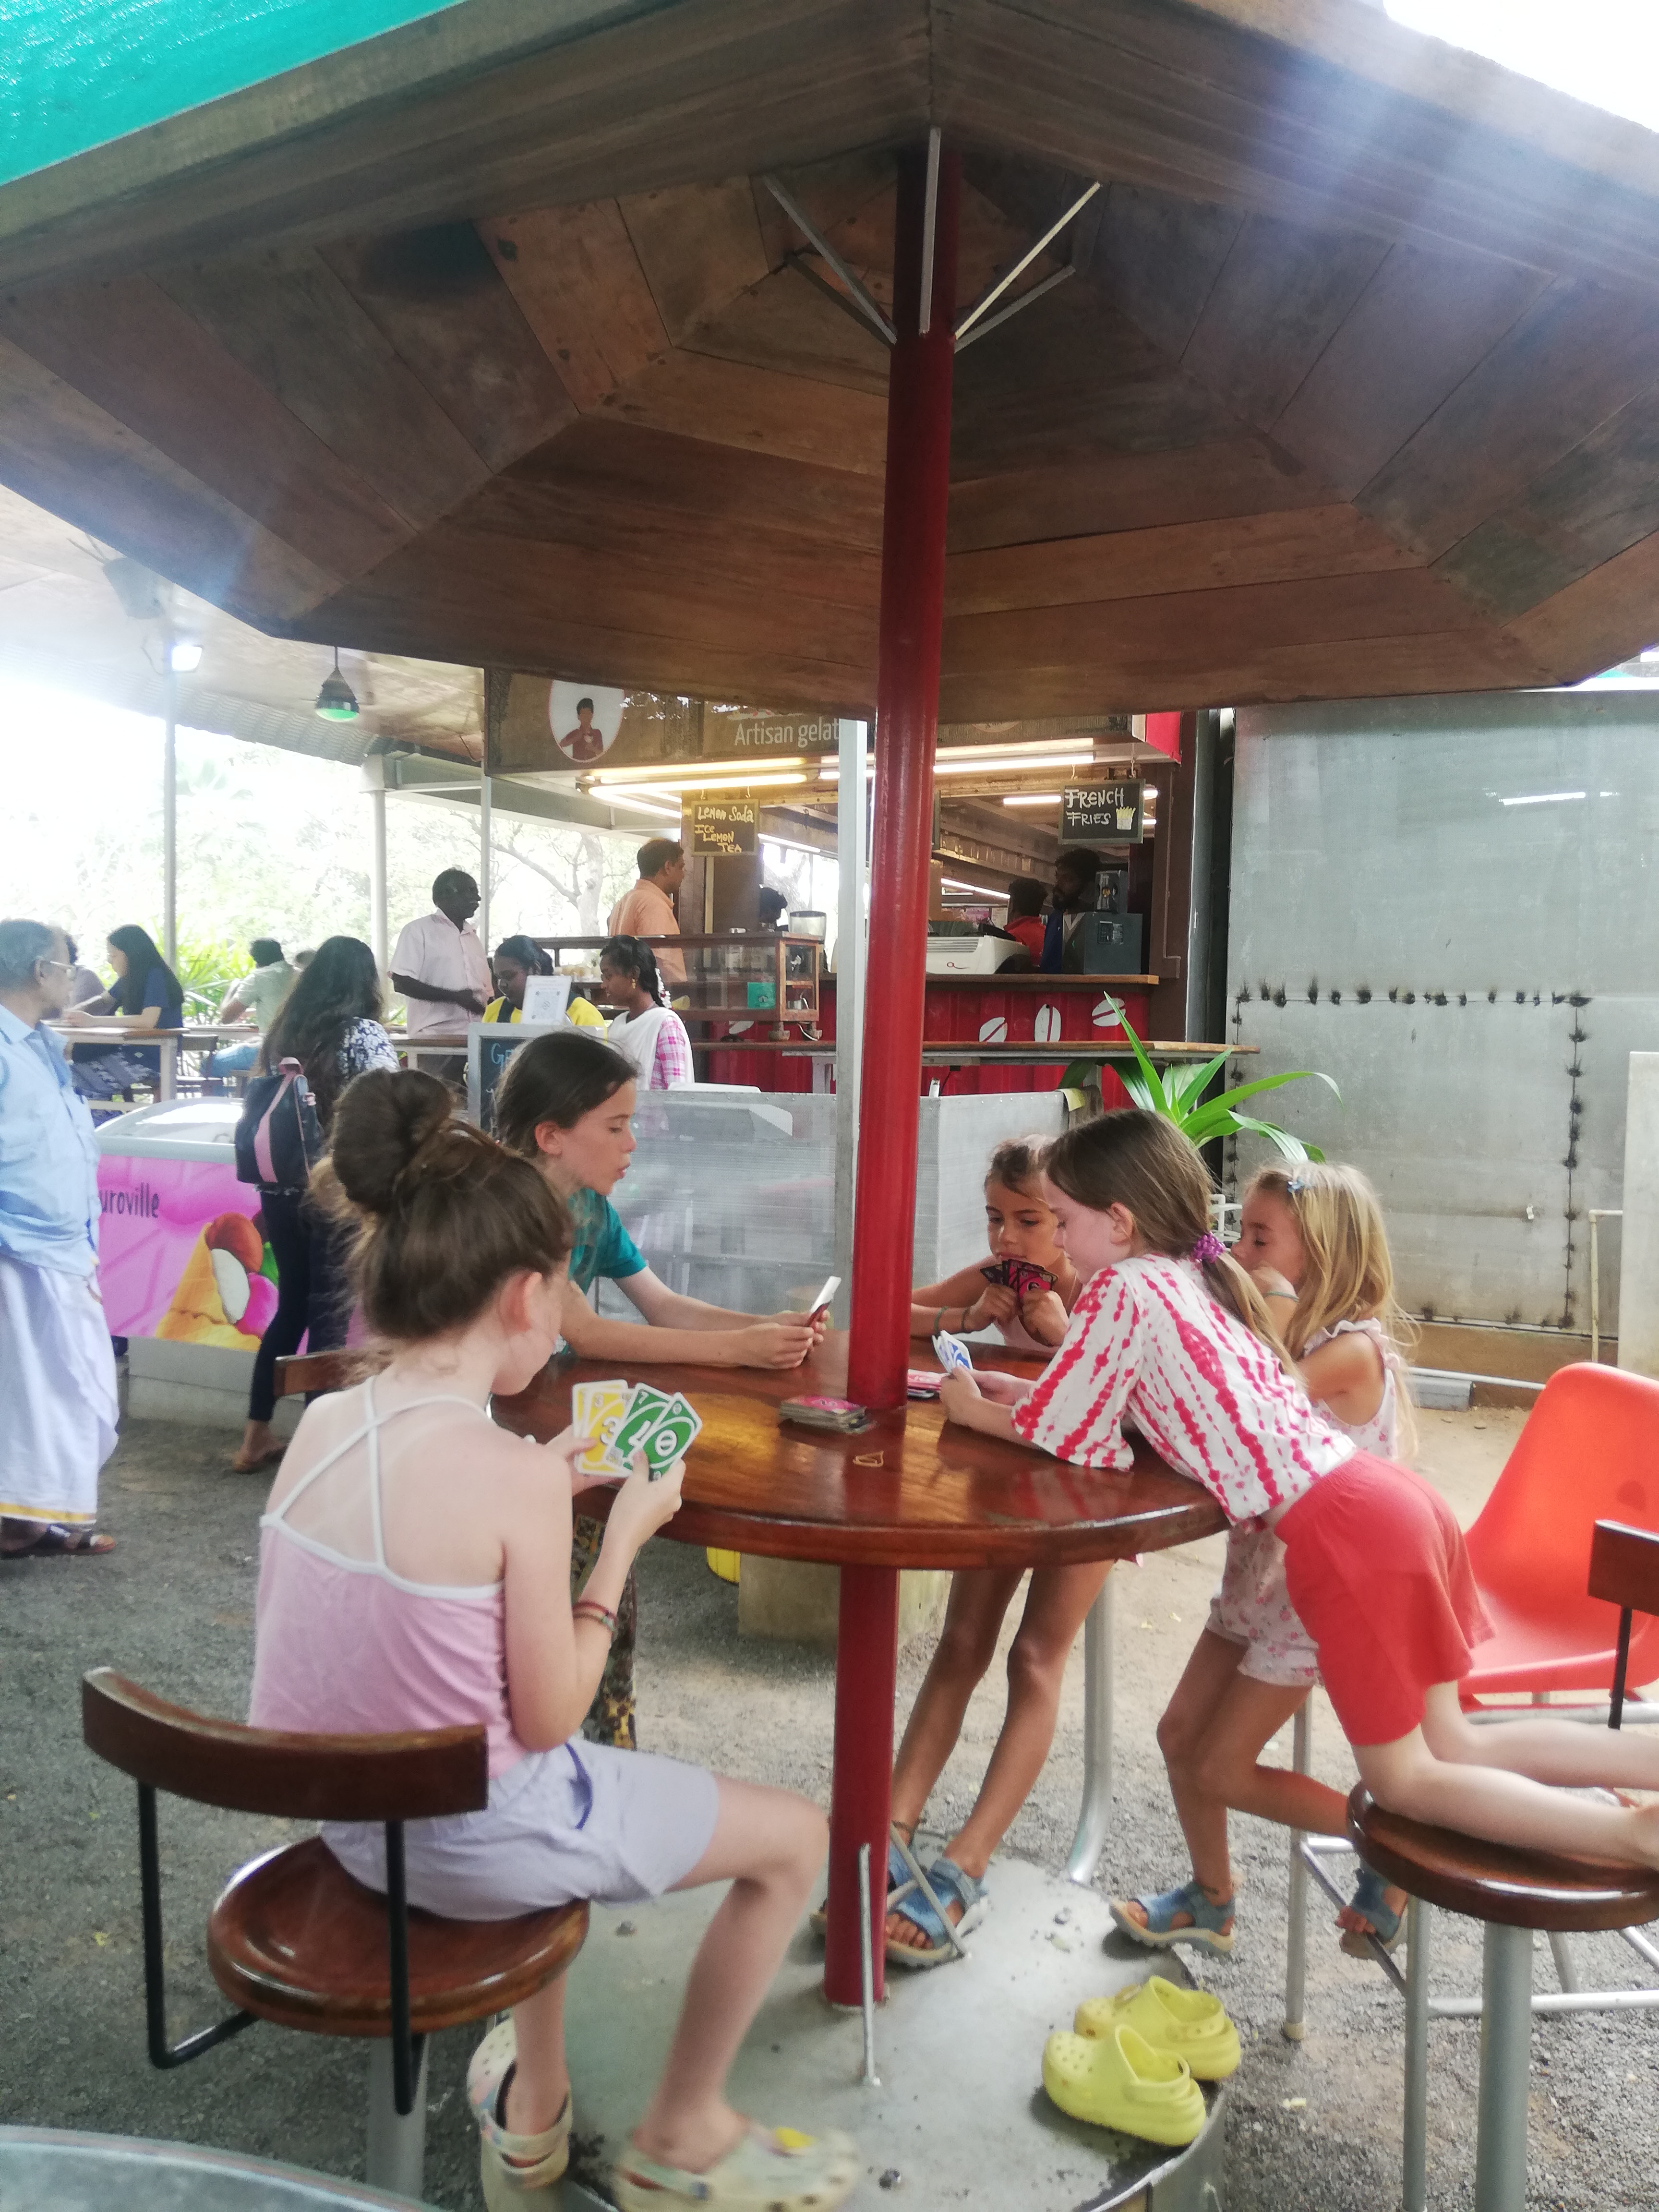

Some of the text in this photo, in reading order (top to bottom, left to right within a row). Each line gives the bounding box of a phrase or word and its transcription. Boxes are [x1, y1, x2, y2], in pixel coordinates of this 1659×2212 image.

[734, 716, 839, 748] Artisan gelat
[1064, 787, 1124, 809] FRENCH
[729, 805, 754, 823] Soda
[1066, 811, 1111, 826] FRIES
[717, 842, 742, 853] TEA
[98, 1182, 159, 1218] uroville
